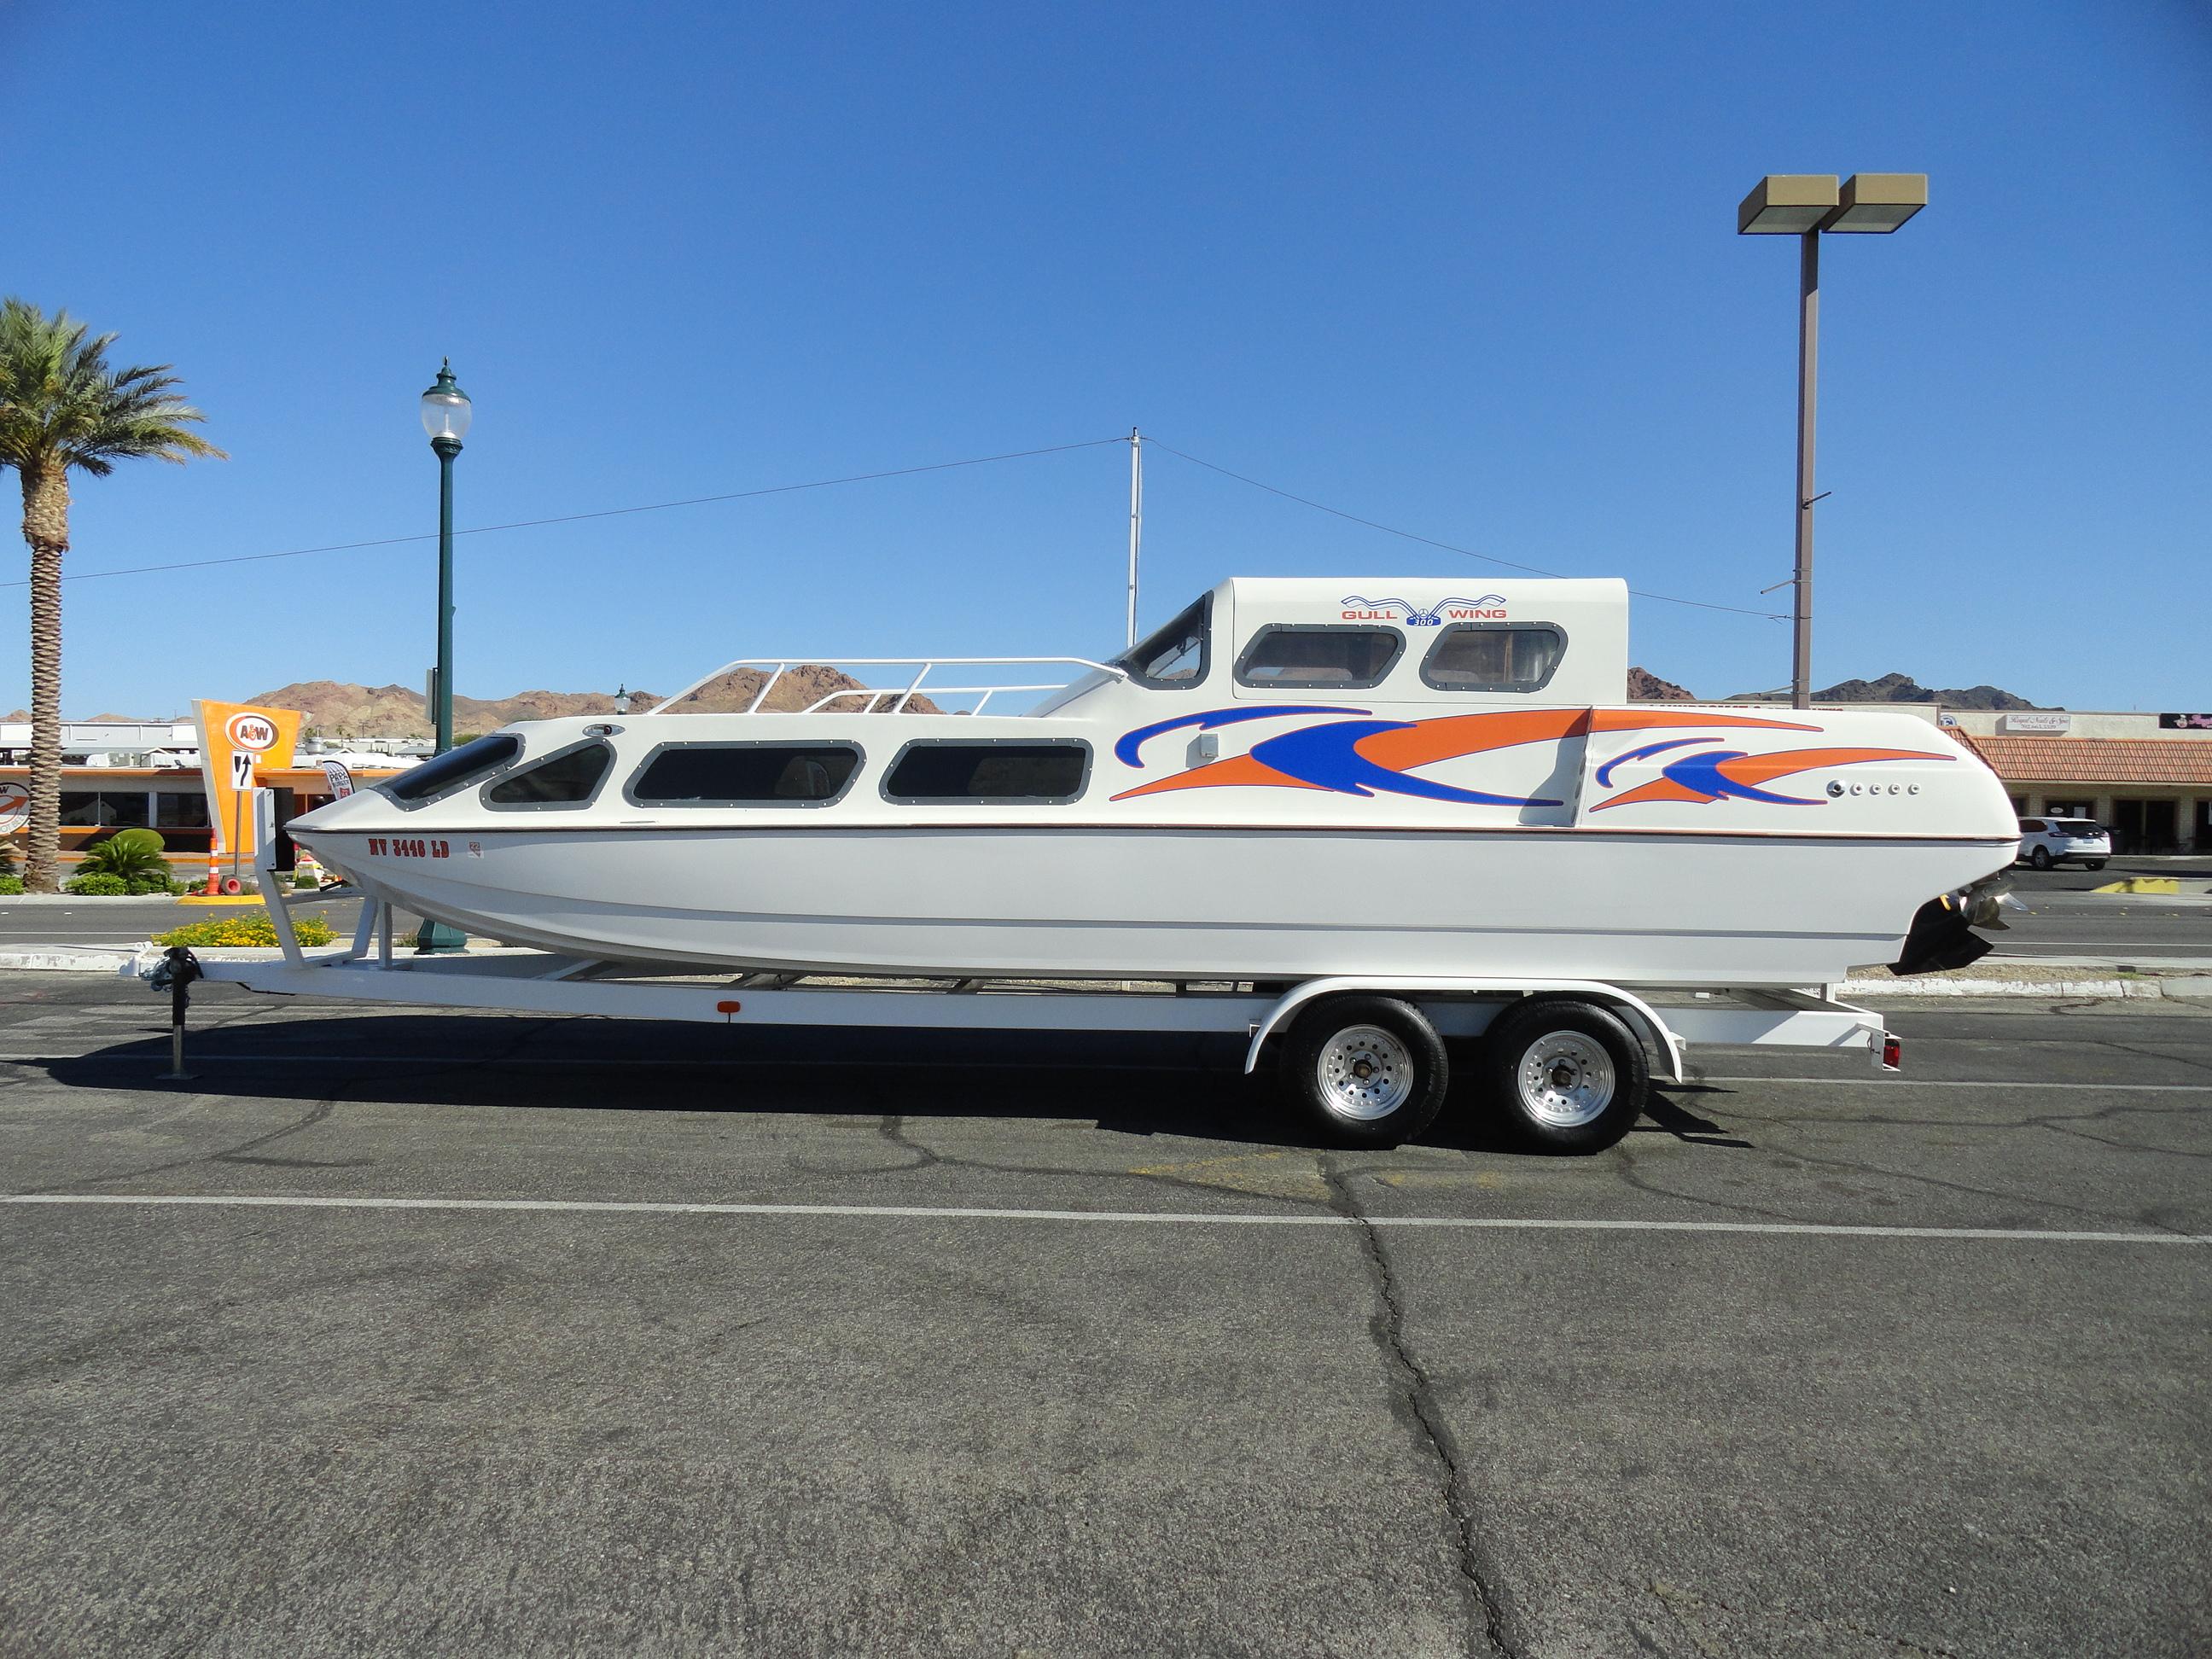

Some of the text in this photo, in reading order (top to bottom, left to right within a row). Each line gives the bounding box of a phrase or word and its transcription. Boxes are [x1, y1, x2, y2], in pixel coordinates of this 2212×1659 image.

[1342, 609, 1507, 620] GULL WING
[240, 724, 269, 741] A&W
[368, 838, 387, 856] NV
[431, 840, 450, 859] LD
